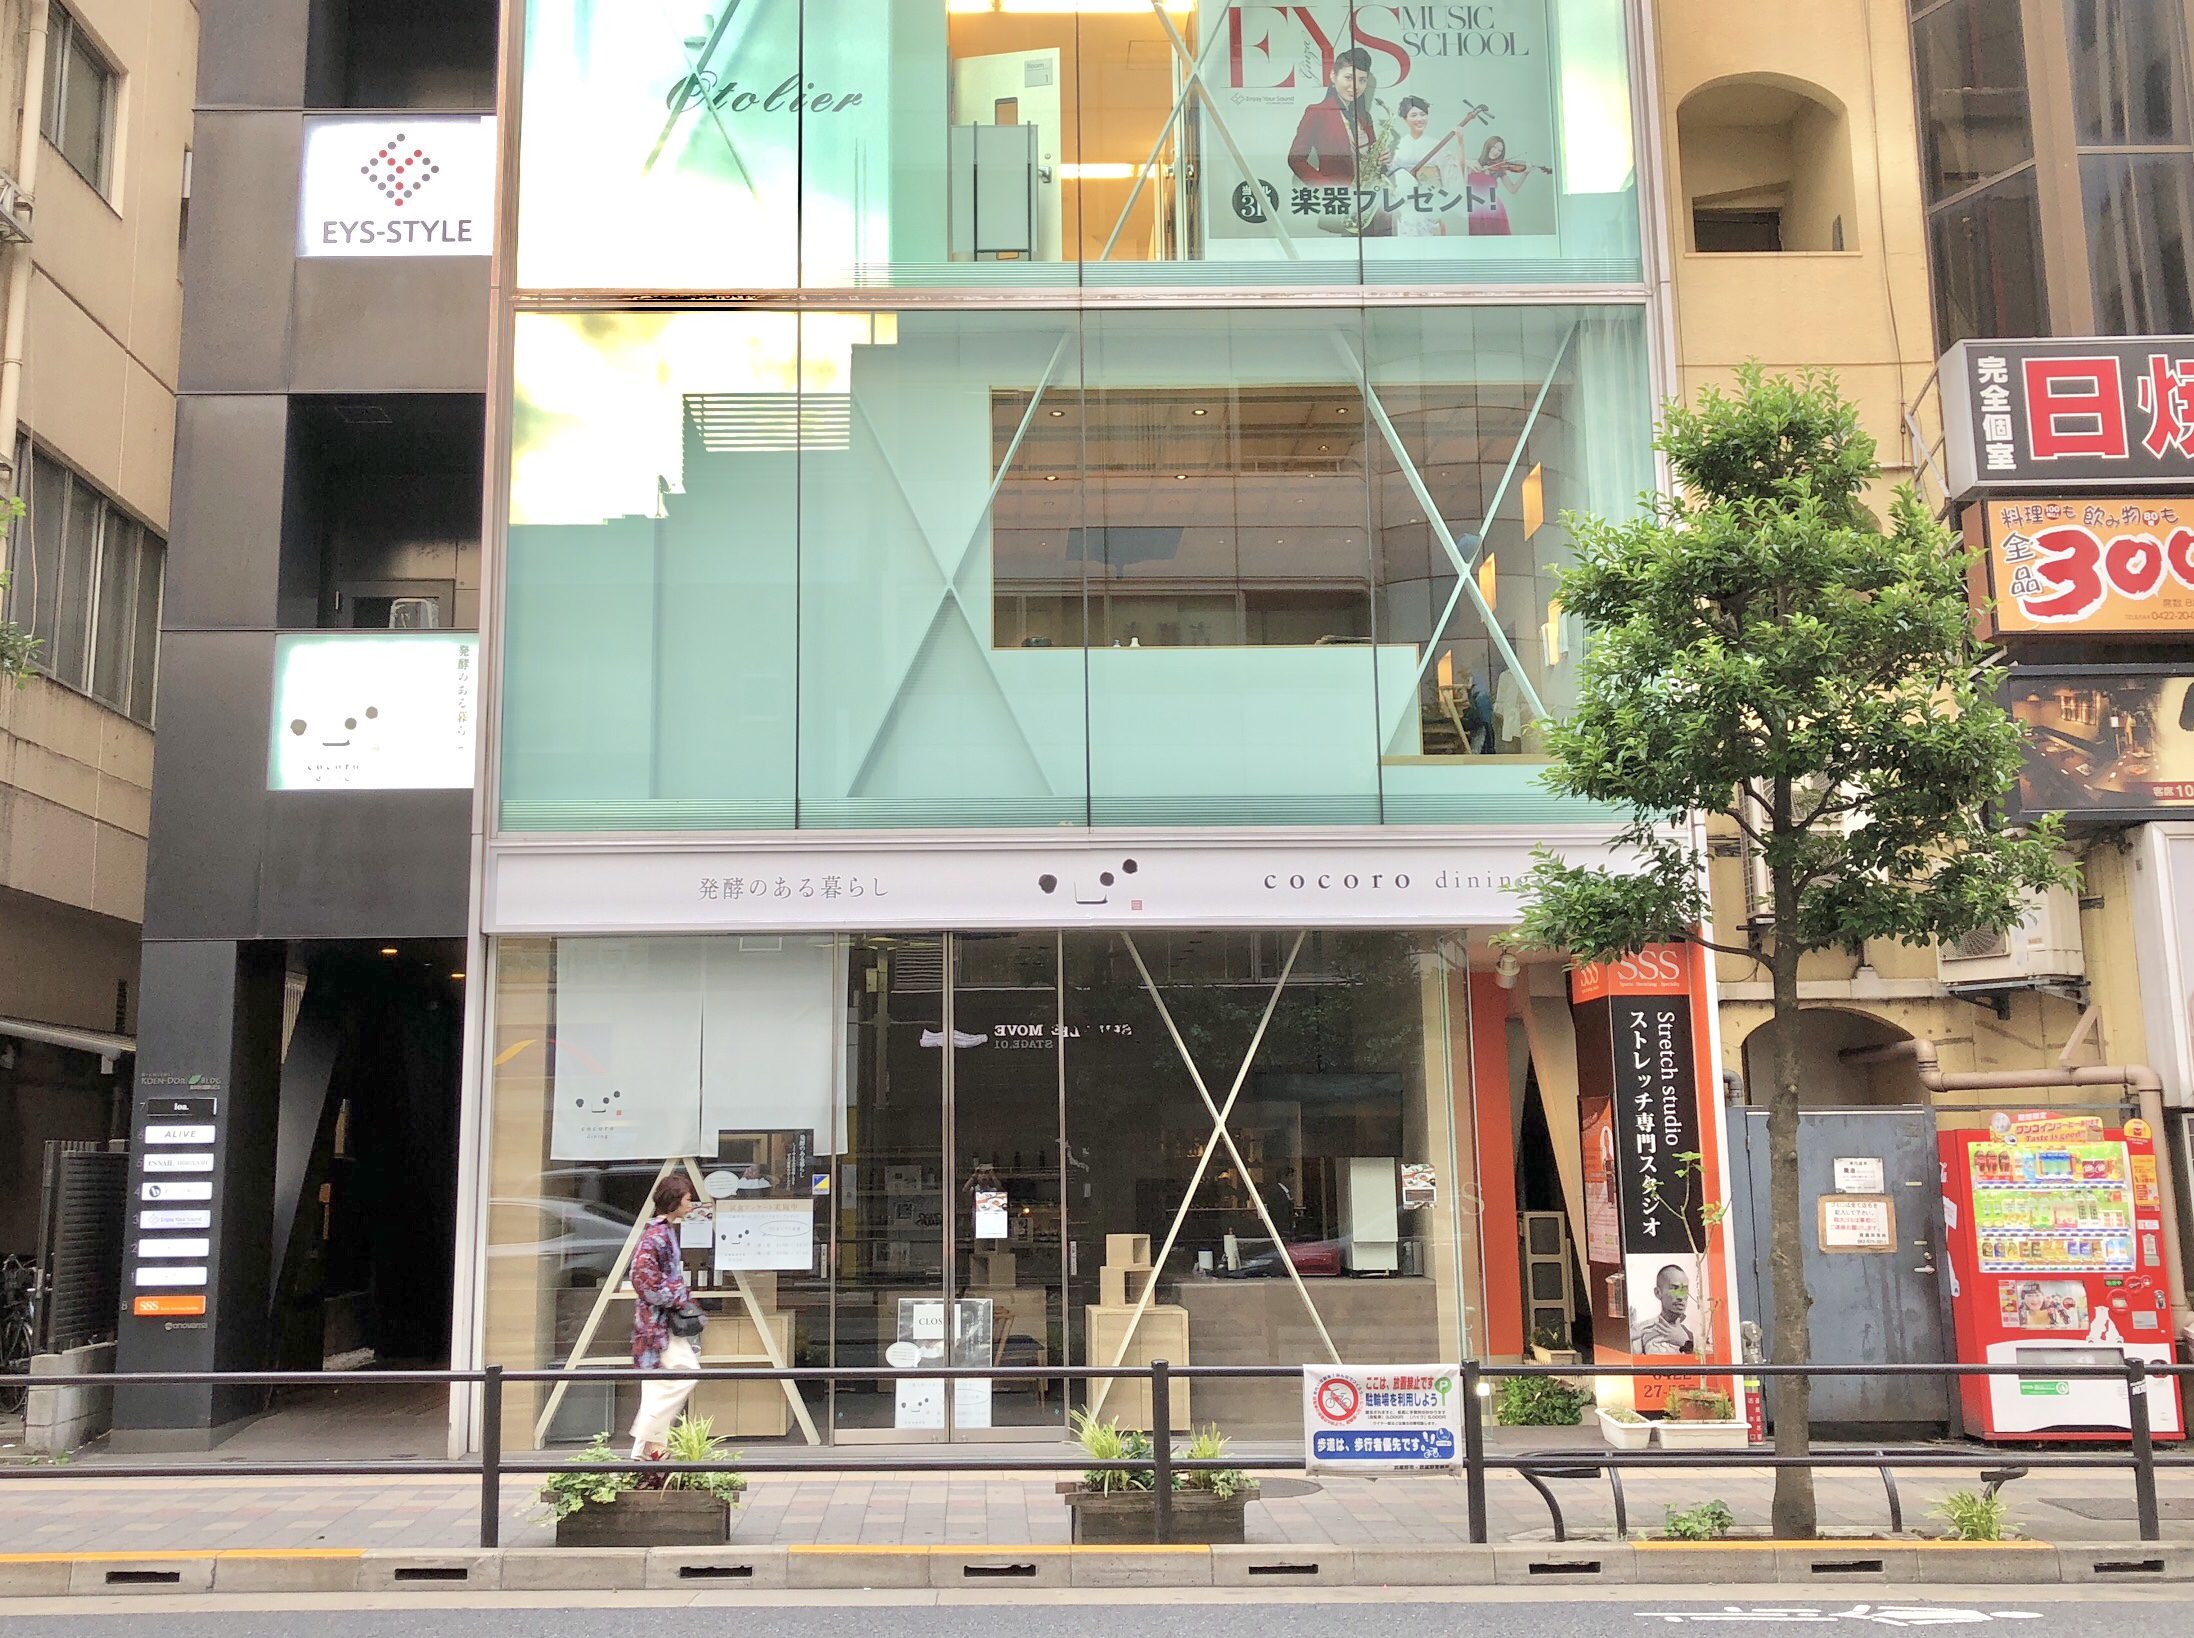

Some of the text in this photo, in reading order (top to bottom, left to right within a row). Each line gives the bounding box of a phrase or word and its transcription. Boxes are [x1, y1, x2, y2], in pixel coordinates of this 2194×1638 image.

[1402, 5, 1494, 30] MUSIC
[1402, 31, 1529, 57] SCHOOL
[322, 219, 472, 244] EYS-STYLE
[1977, 355, 2017, 471] 完全個室
[698, 876, 889, 900] 発酵のある暮らし
[1264, 874, 1411, 890] cocoro
[1657, 1011, 1683, 1146] Stretch studio
[1630, 1011, 1661, 1238] ストレッチ専門スタジオ
[164, 1130, 197, 1138] ALIVE
[2025, 1134, 2049, 1142] Taste
[131, 1243, 138, 1253] 2
[140, 1301, 159, 1310] SSS
[1365, 1376, 1434, 1390] ここは、放置禁止です
[1365, 1393, 1438, 1407] 駐輪場を利用しよう
[1317, 1437, 1426, 1452] 歩道は、歩行者優先です。
